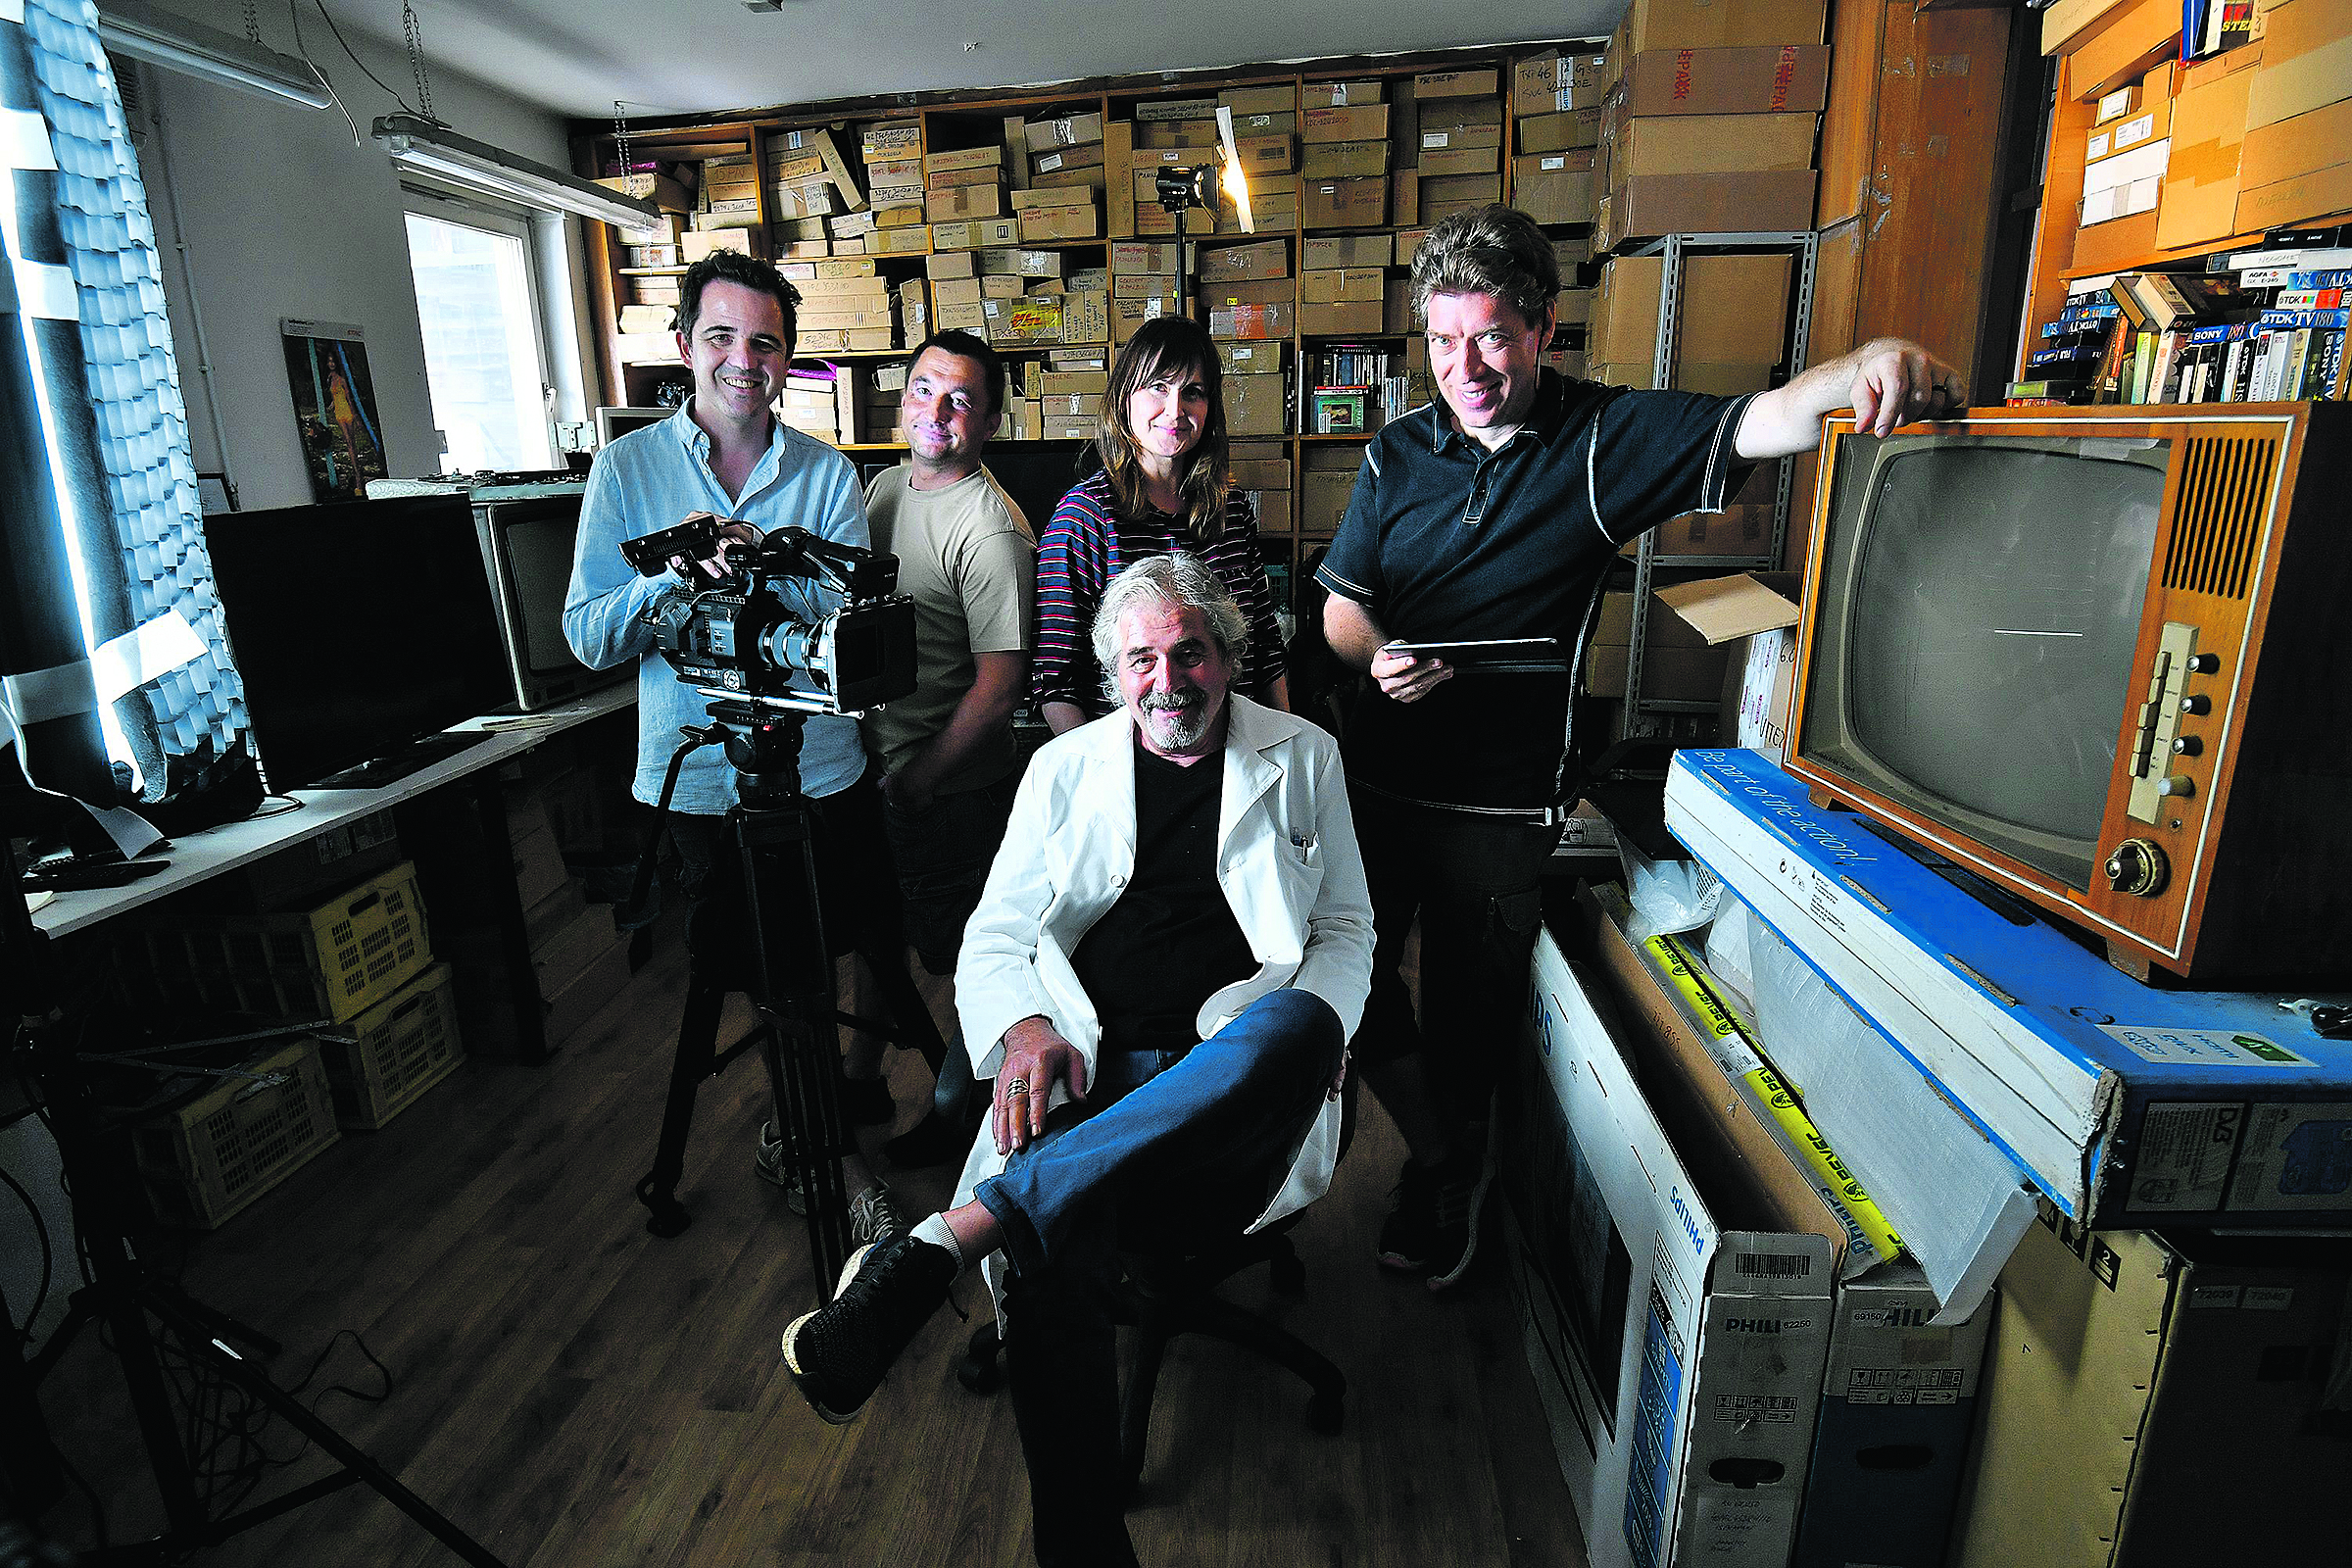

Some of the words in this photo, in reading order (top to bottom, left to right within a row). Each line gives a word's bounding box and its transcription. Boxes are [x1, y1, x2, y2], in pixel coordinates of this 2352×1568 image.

[2221, 20, 2251, 32] STE
[2269, 314, 2295, 324] TDK
[2294, 312, 2316, 326] TV
[2314, 313, 2333, 326] 180
[2193, 329, 2223, 341] SONY
[2319, 334, 2332, 381] SONY
[1695, 751, 1725, 763] Be
[1702, 763, 1761, 785] part
[1789, 816, 1879, 862] action!
[1669, 1185, 1705, 1256] PHILIPS
